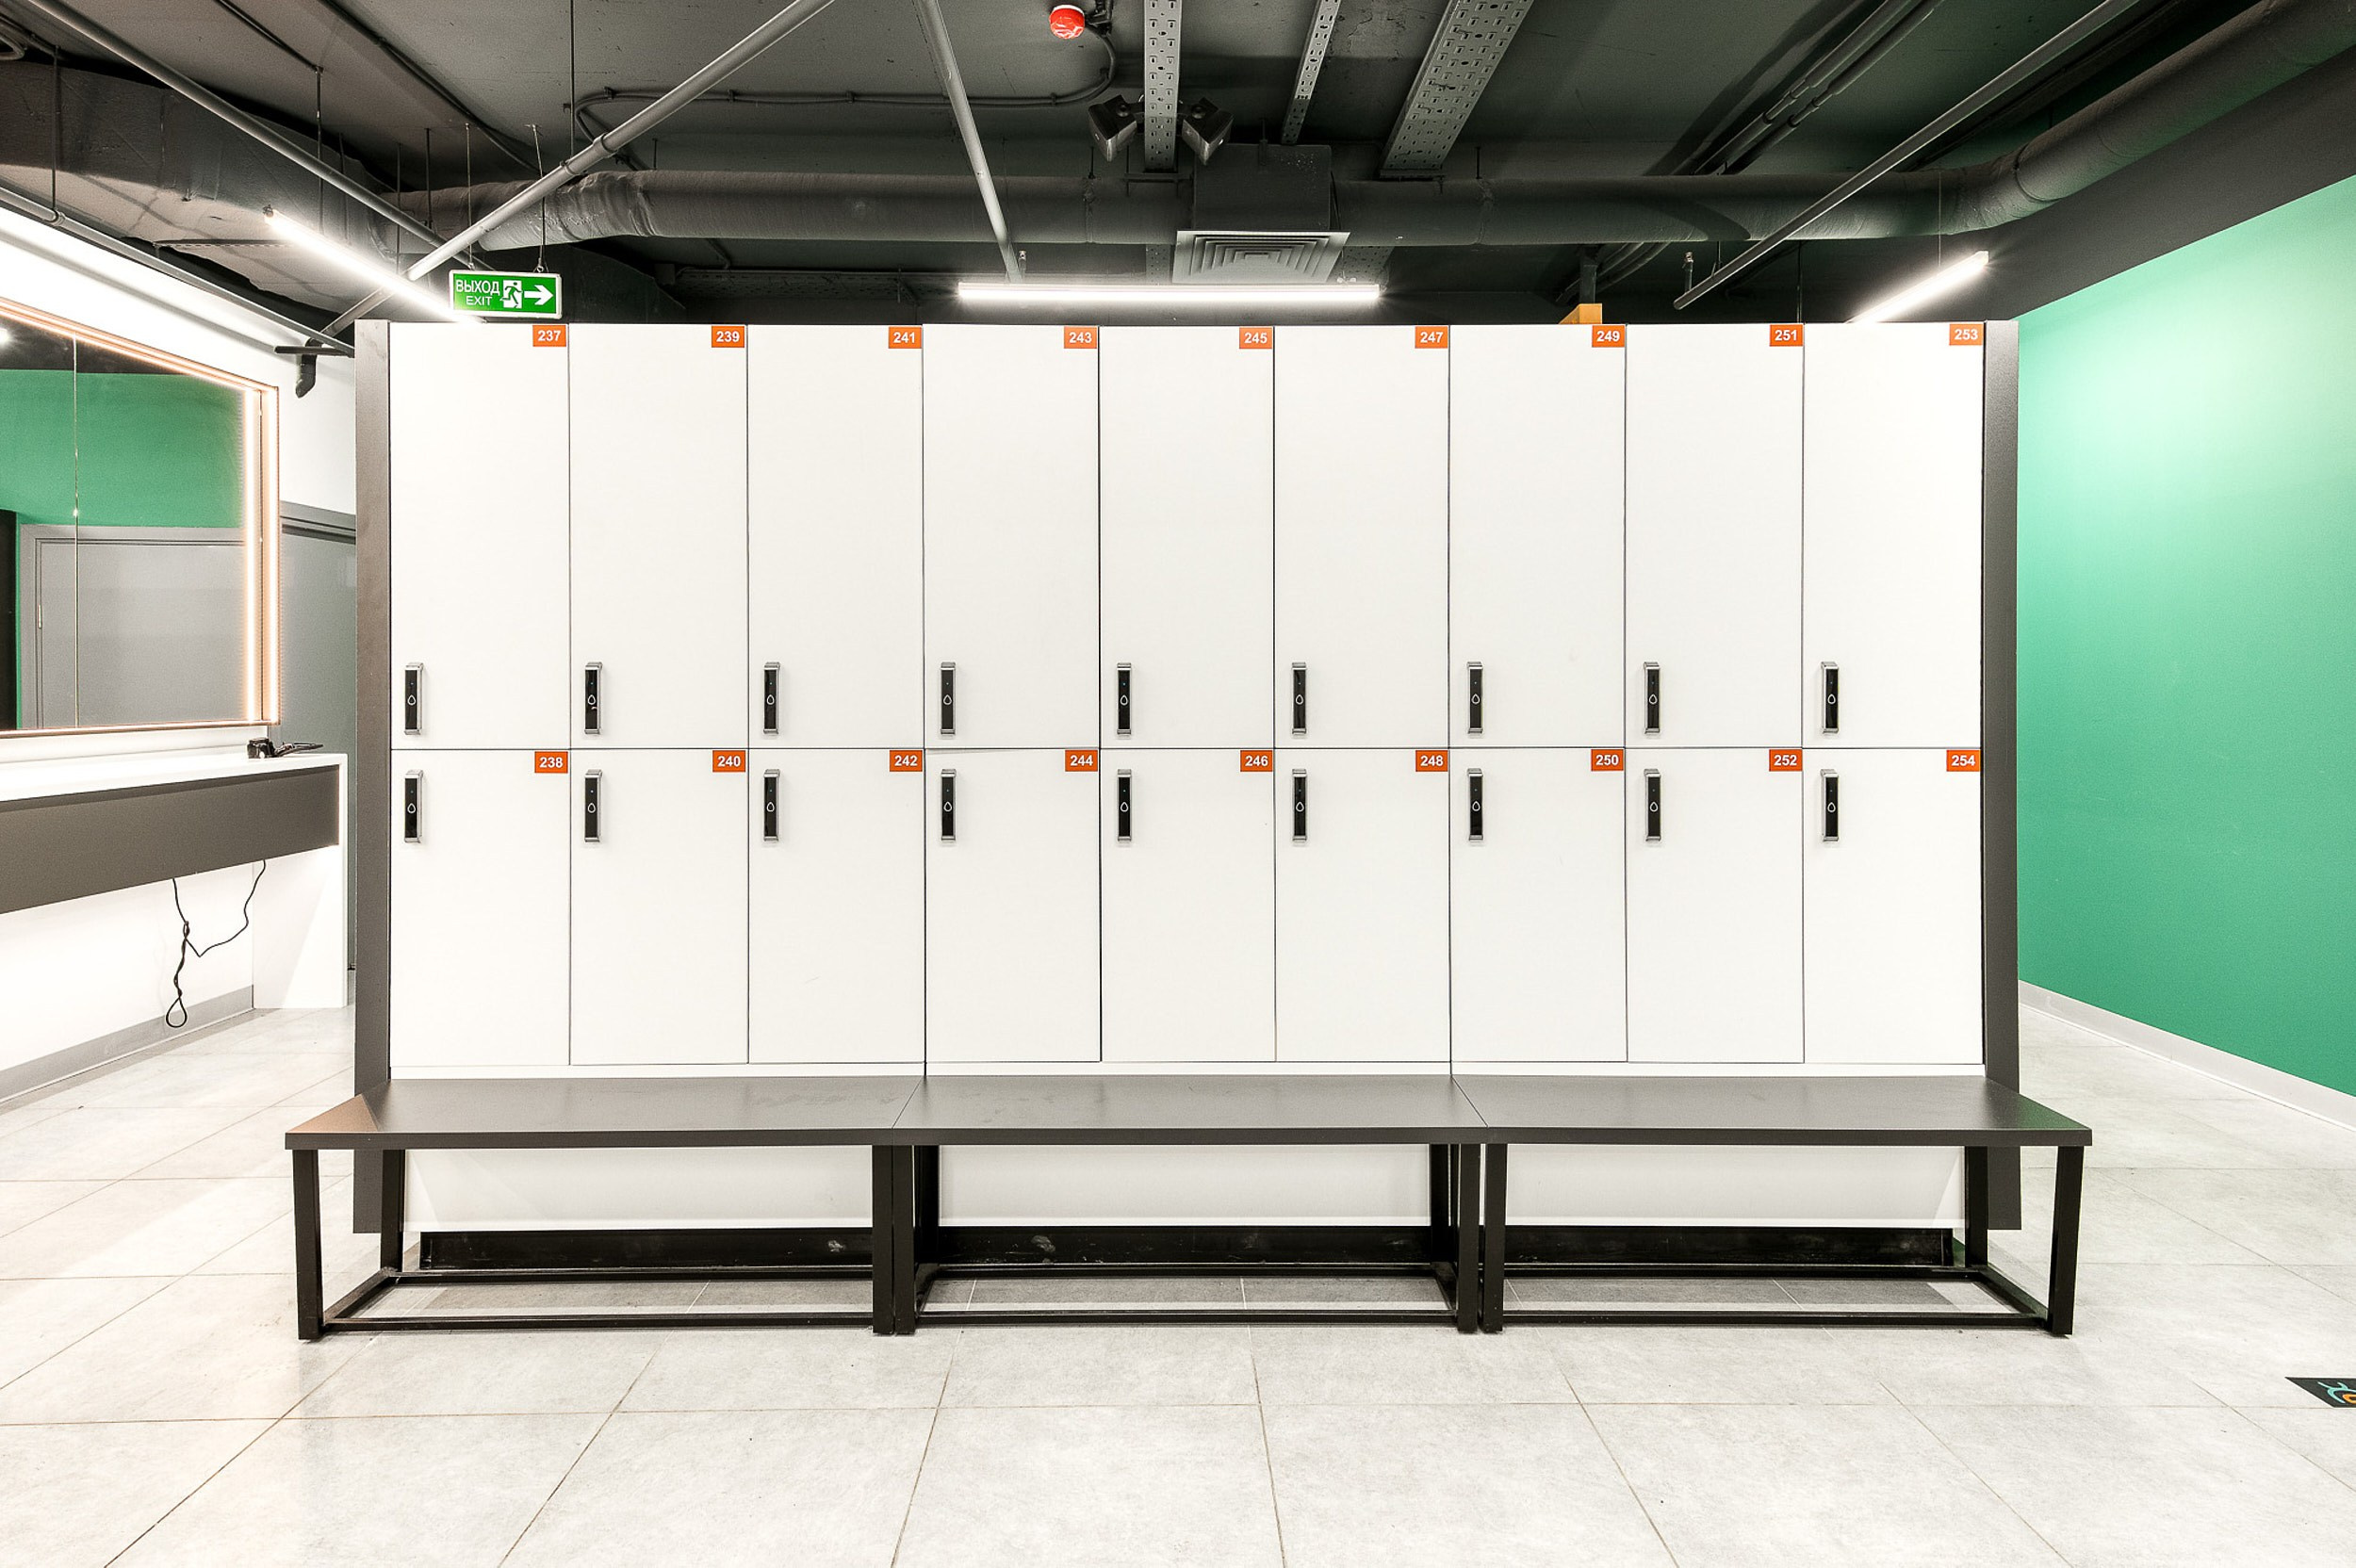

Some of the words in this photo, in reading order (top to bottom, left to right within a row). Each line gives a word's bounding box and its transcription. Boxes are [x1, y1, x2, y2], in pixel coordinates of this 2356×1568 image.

[455, 279, 499, 296] ВЫХОД
[466, 296, 492, 305] EXIT
[537, 329, 562, 342] 237
[715, 330, 740, 343] 239
[893, 331, 915, 344] 241
[1069, 331, 1092, 344] 243
[1244, 331, 1268, 344] 245
[1420, 331, 1444, 343] 247
[1596, 330, 1620, 342] 249
[1775, 329, 1797, 341] 251
[1954, 327, 1979, 341] 253
[539, 757, 564, 769] 238
[717, 755, 742, 767] 240
[894, 755, 918, 767] 242
[1070, 755, 1094, 766] 244
[1245, 755, 1268, 767] 246
[1420, 755, 1444, 767] 248
[1595, 754, 1619, 766] 250
[1774, 754, 1797, 766] 252
[1951, 754, 1976, 767] 254
